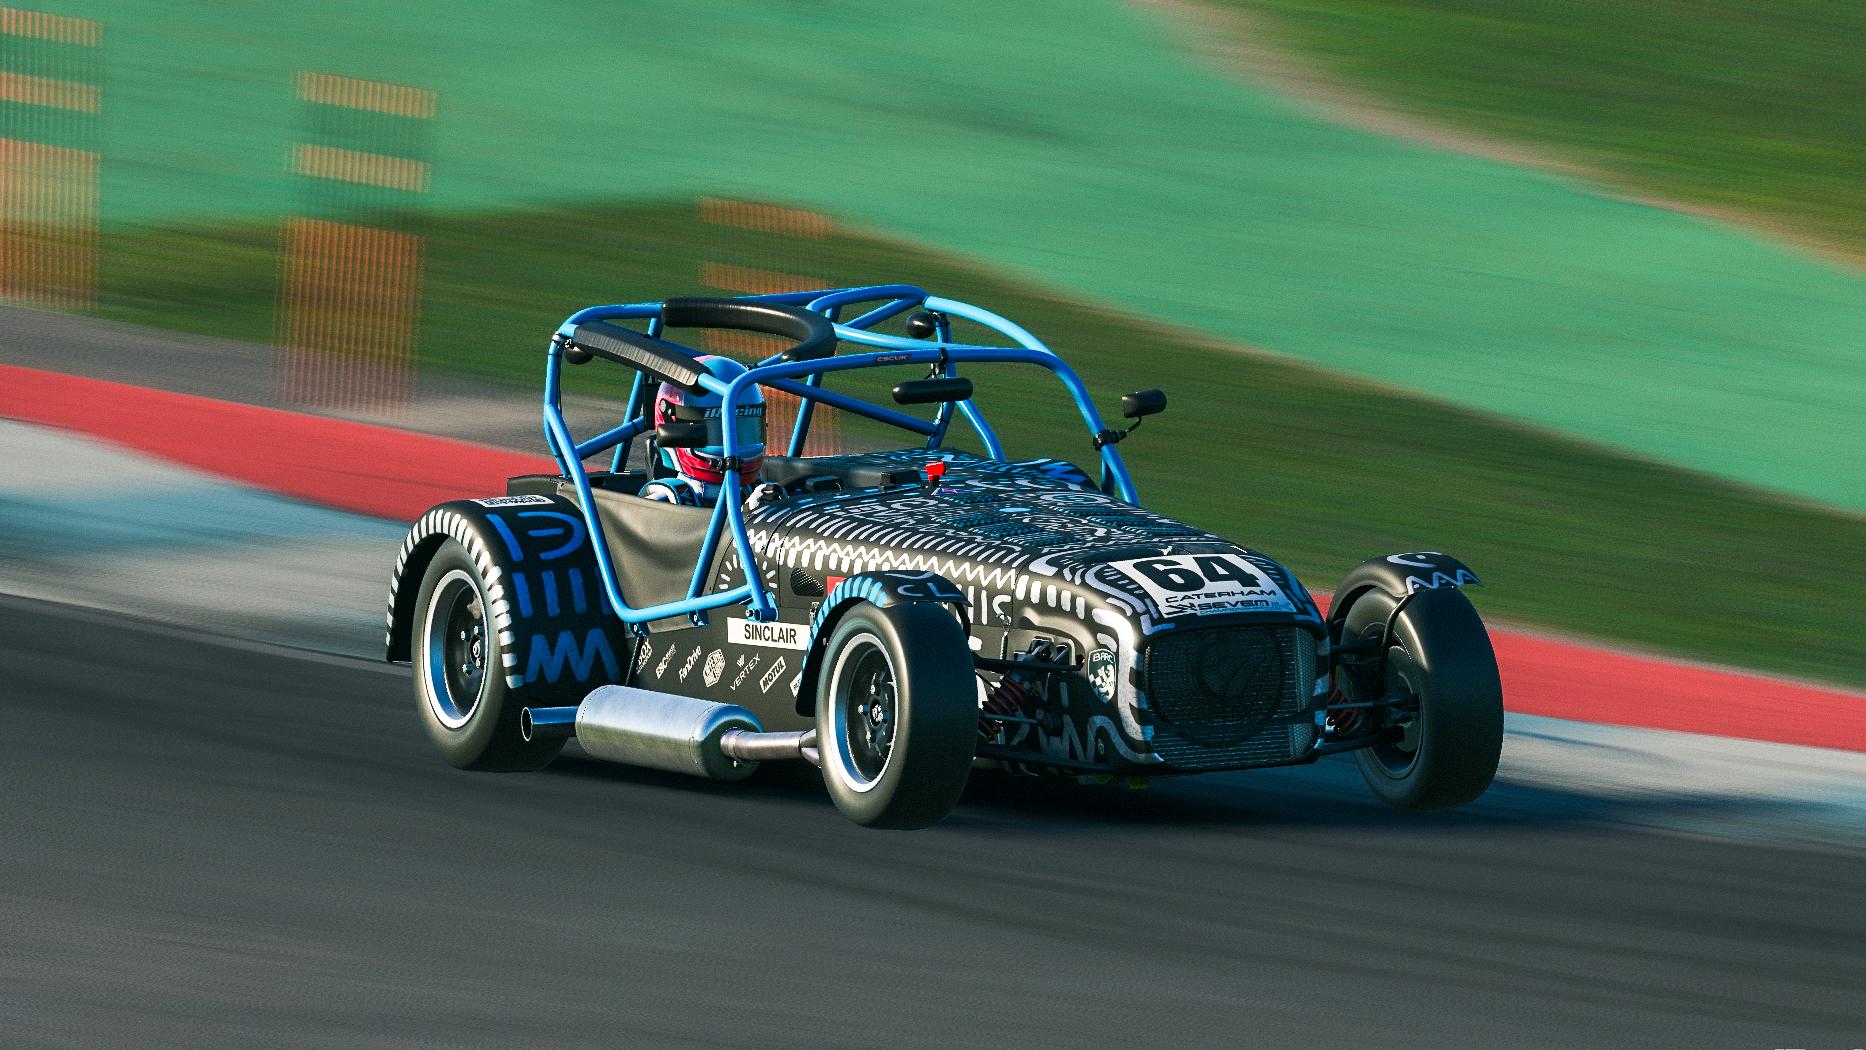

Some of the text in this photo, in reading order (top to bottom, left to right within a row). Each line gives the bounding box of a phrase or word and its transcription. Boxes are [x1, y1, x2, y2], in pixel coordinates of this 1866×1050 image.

[704, 406, 762, 418] iRcing
[1132, 556, 1262, 593] 64
[1165, 590, 1277, 603] CATERHAM
[1198, 599, 1270, 611] SEVEN
[744, 623, 797, 644] SINCLAIR
[1092, 652, 1114, 664] BARC
[730, 652, 761, 691] VERTEX
[762, 661, 785, 690] MOTUL
